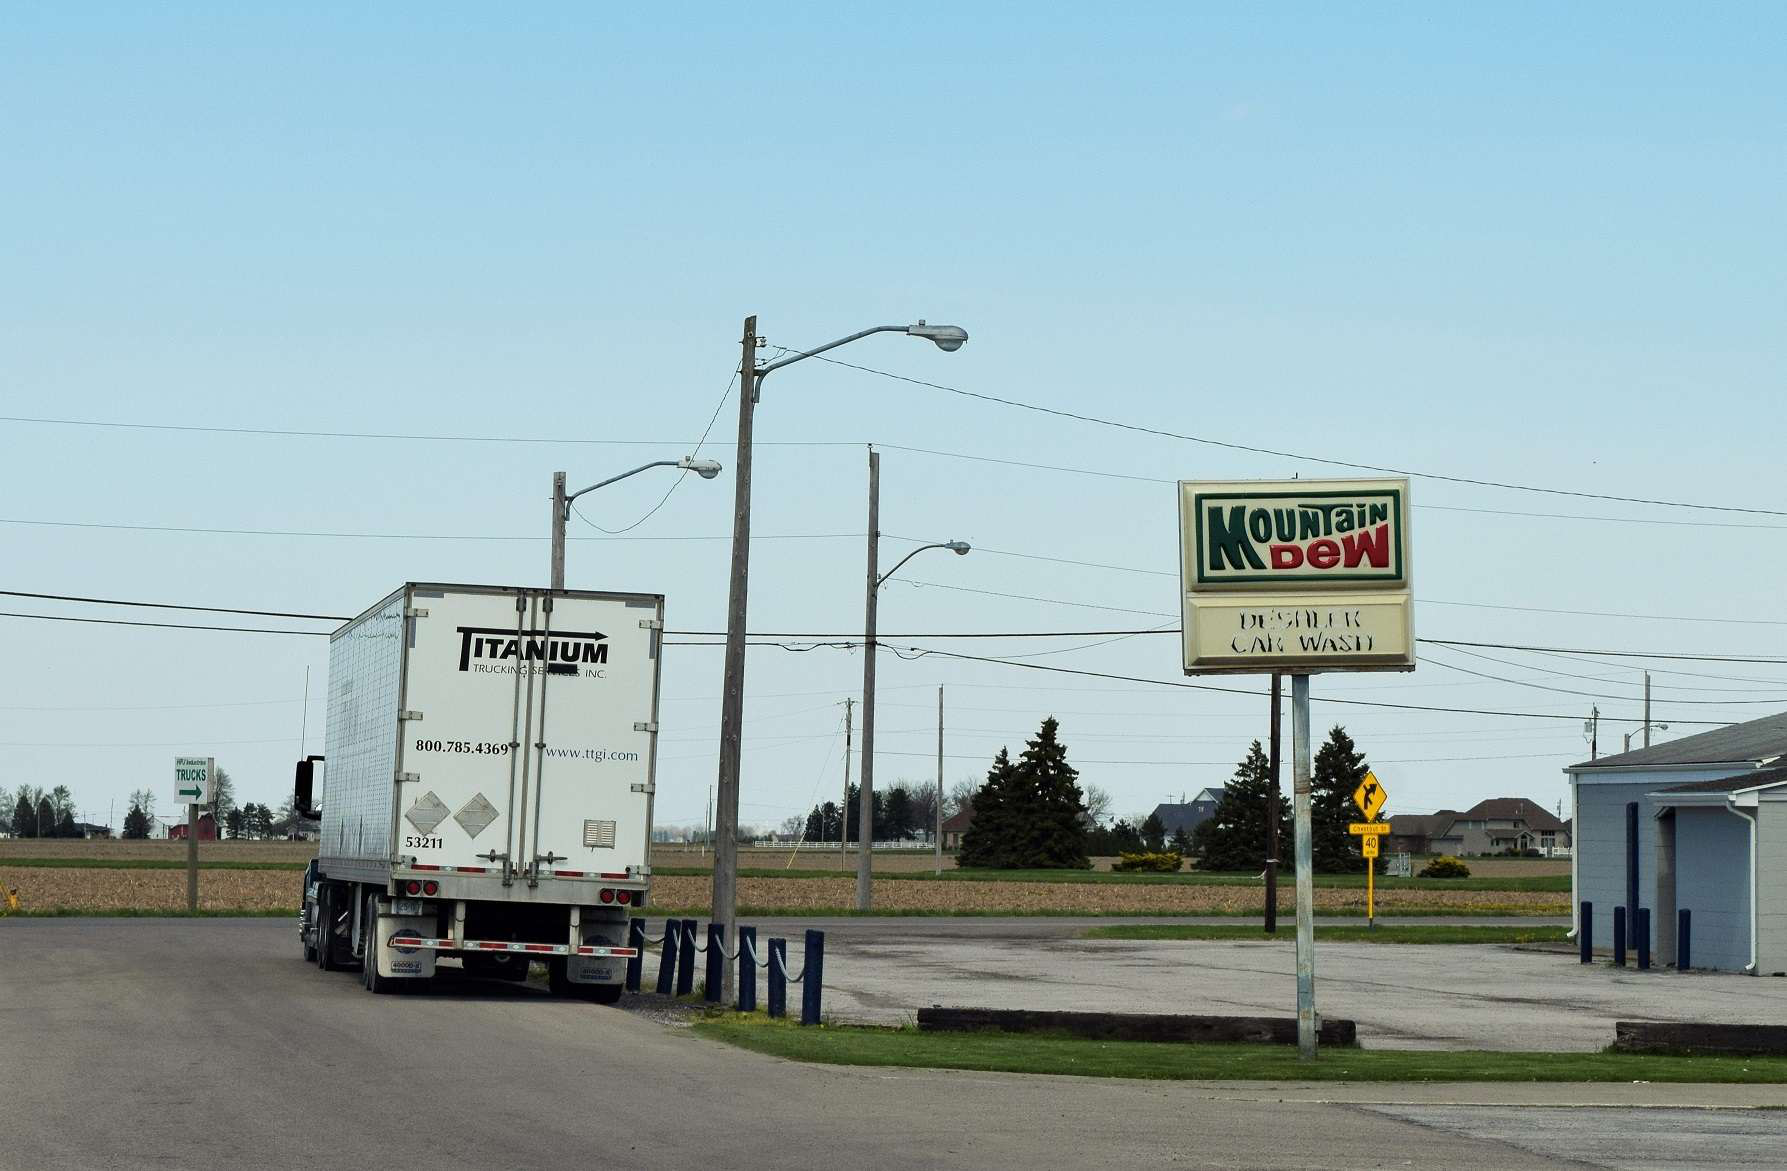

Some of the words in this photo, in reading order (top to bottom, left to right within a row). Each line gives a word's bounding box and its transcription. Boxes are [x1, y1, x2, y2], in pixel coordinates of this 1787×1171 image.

[457, 626, 609, 671] TITANIUM
[585, 669, 608, 679] INC.
[415, 739, 509, 756] 800.785.4369
[546, 748, 639, 763] www.ttgi.com
[176, 769, 206, 781] TRUCKS
[405, 836, 443, 849] 53211
[1365, 837, 1377, 849] 40
